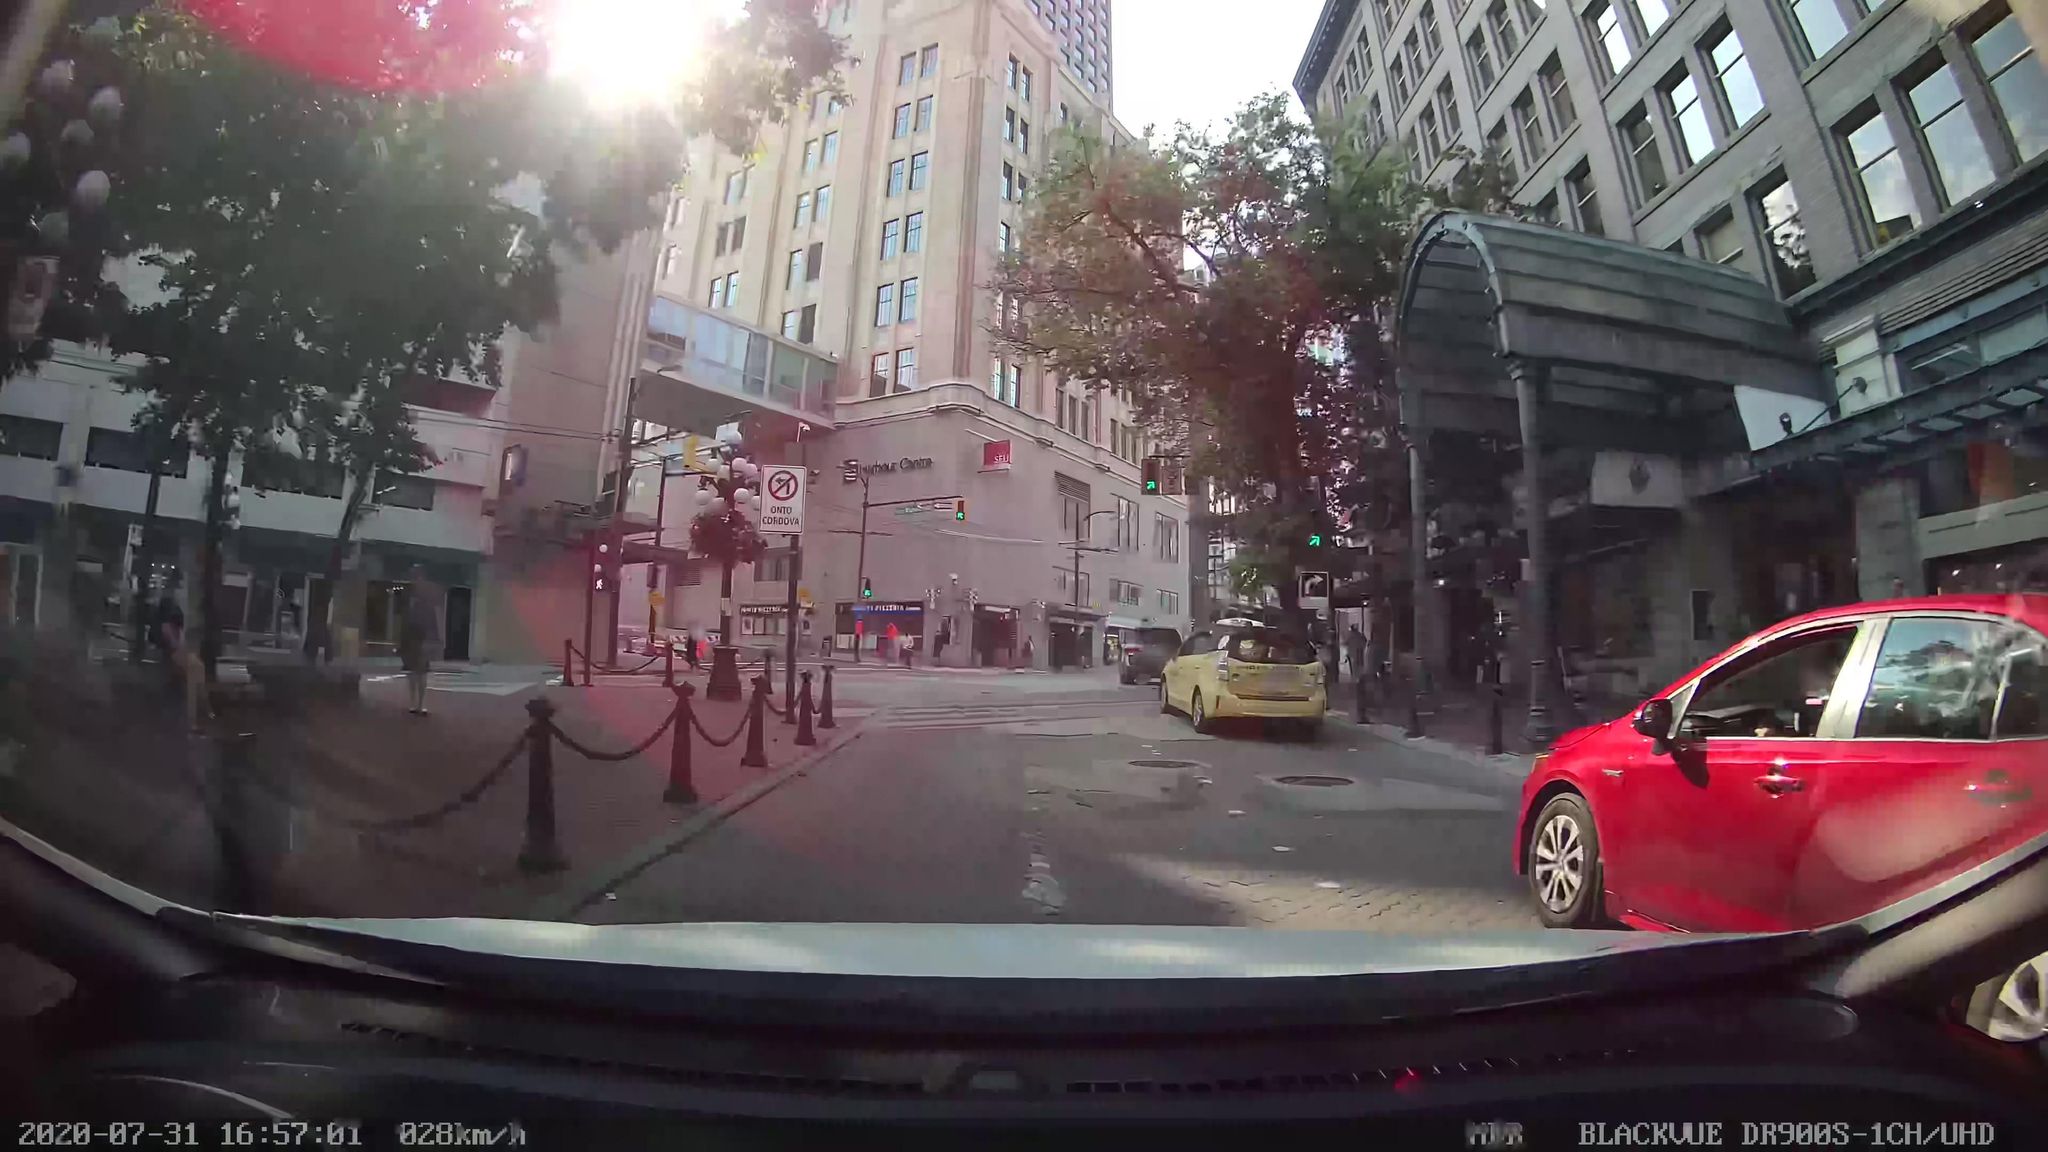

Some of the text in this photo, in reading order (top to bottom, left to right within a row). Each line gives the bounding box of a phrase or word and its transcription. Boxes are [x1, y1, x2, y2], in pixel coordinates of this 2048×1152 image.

[993, 453, 1009, 463] SFU
[900, 457, 934, 470] Centre
[770, 506, 793, 515] ONTO
[762, 516, 800, 526] CORDOVA
